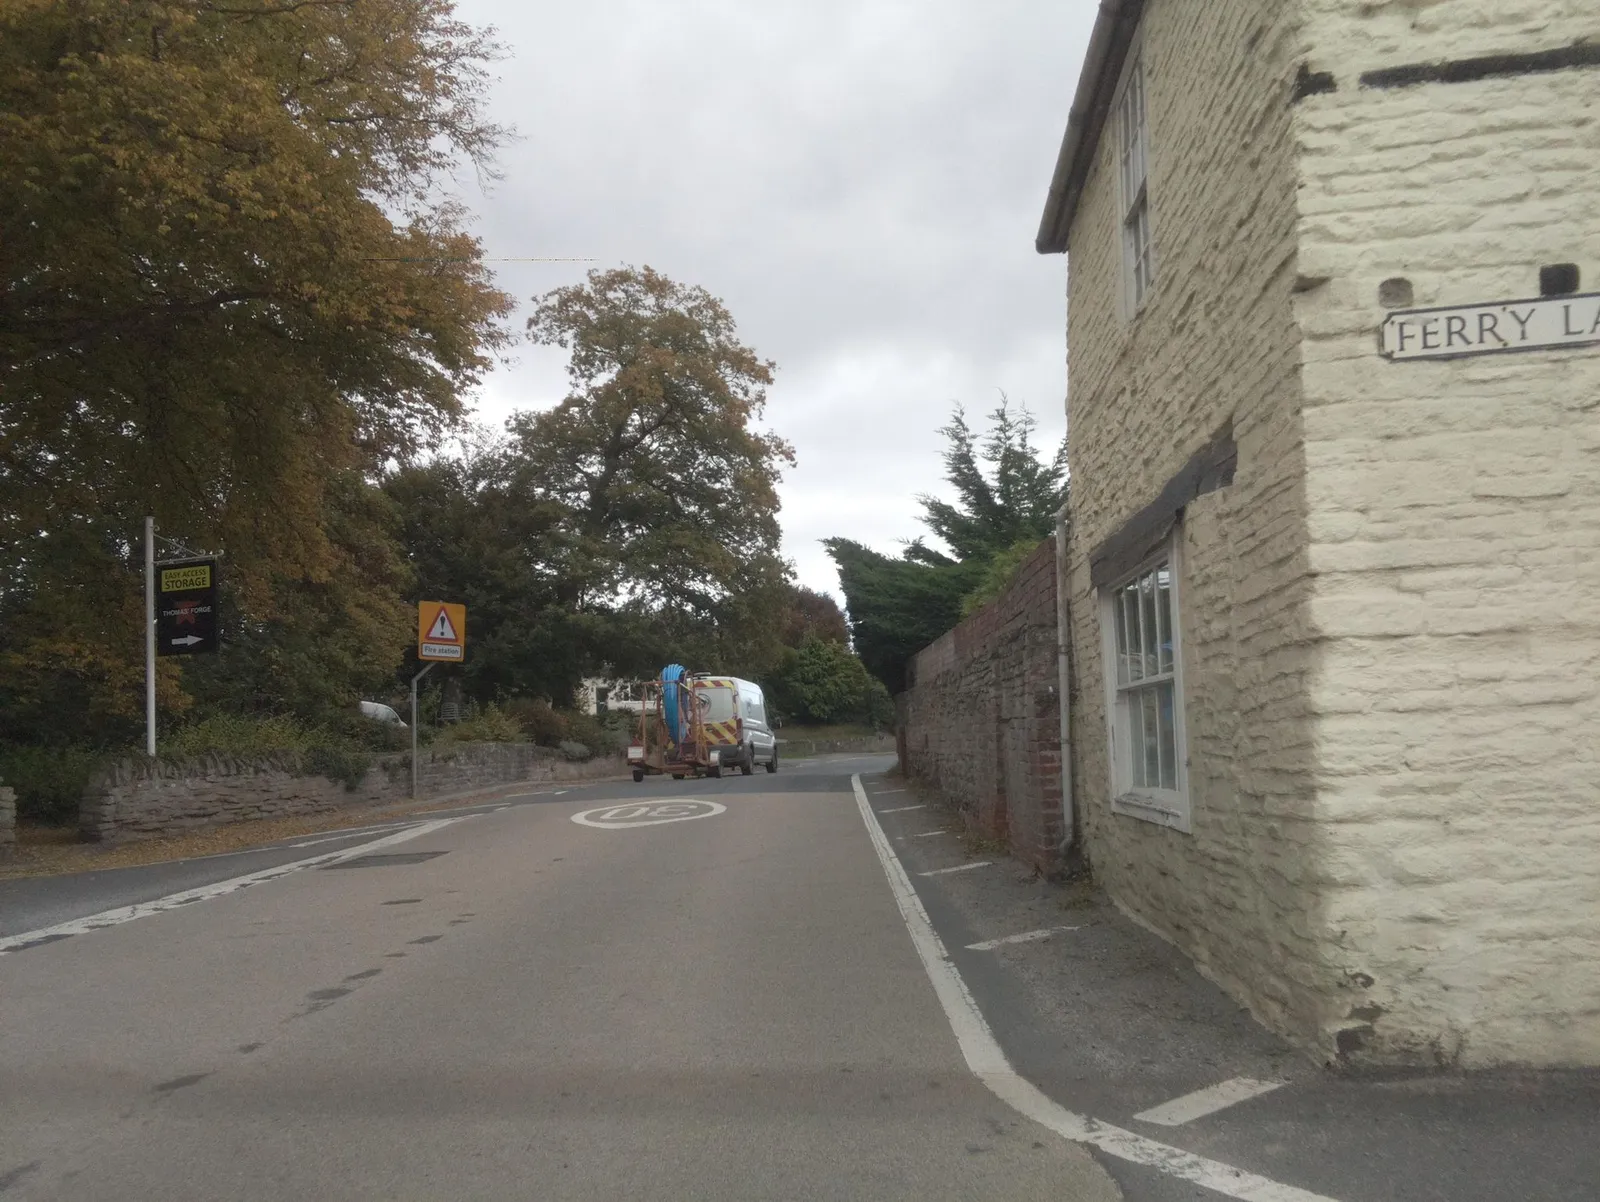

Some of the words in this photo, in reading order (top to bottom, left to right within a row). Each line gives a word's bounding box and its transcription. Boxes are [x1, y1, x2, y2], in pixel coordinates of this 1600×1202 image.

[1398, 308, 1535, 352] FERRY
[165, 571, 180, 579] EASY
[182, 569, 206, 577] ACCESS
[165, 577, 206, 589] STORAGE
[438, 647, 459, 655] station
